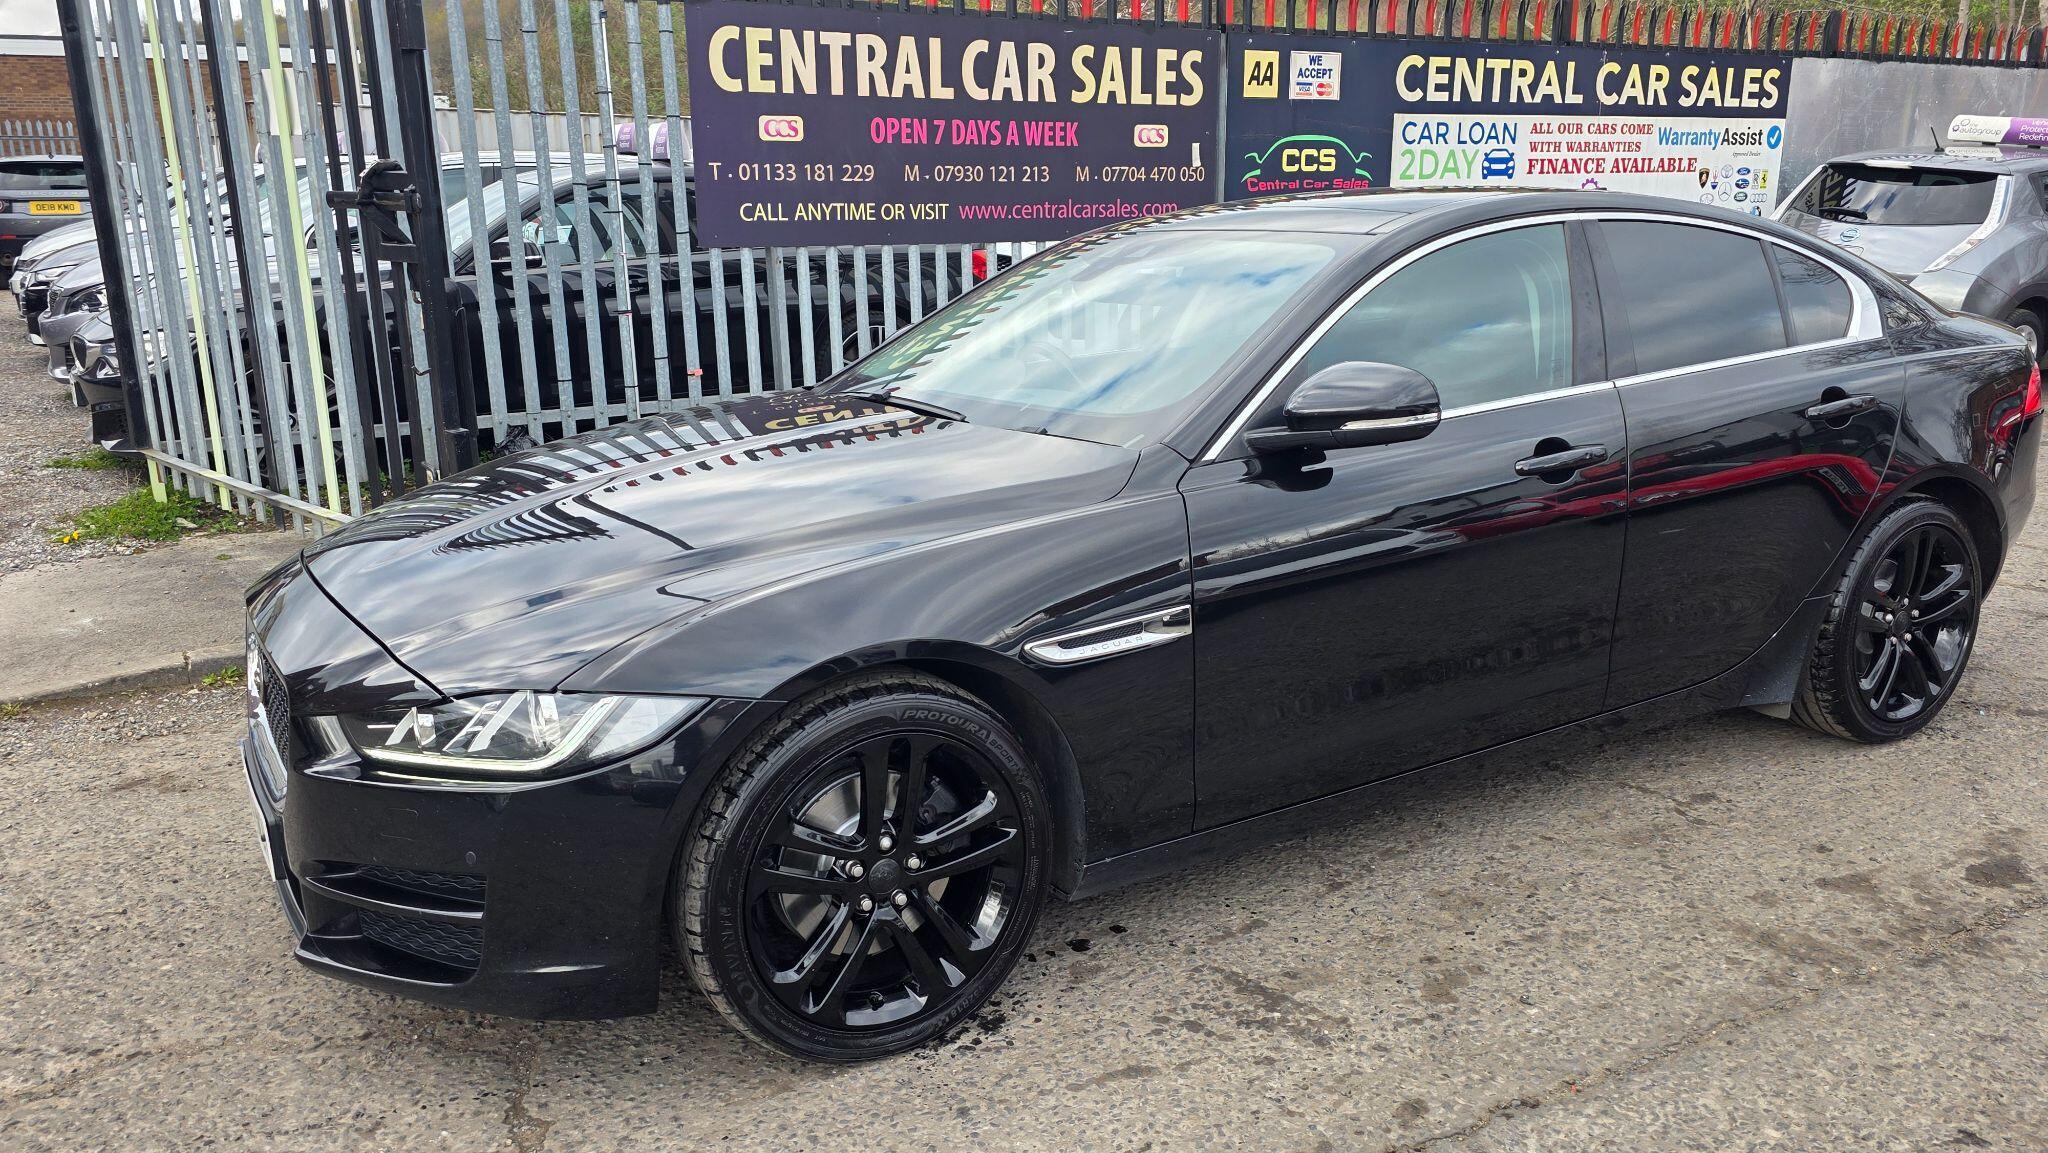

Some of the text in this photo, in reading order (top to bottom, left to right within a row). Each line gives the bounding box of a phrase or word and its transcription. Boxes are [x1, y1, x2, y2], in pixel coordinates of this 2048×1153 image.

[708, 25, 1204, 107] CENTRAL CAR SALES
[1309, 55, 1322, 66] WE
[1247, 61, 1274, 86] AA
[1297, 68, 1333, 79] ACCEPT
[1396, 55, 1781, 109] CENTRAL CAR SALES
[764, 119, 799, 138] CCS
[870, 116, 1079, 147] OPEN 7 DAYS A WEEK
[1402, 121, 1518, 145] CAR LOAN
[1530, 122, 1654, 135] ALL OUR CARS COME
[1658, 126, 1764, 150] WarrantyAssist
[1529, 141, 1642, 153] WITH WARRANTIES
[1281, 149, 1336, 172] CCS
[1400, 149, 1480, 180] 2DAY
[1527, 157, 1698, 175] FINANCE AVAILABLE
[738, 163, 796, 182] 01133
[804, 164, 834, 182] 181
[841, 164, 875, 182] 229
[934, 166, 984, 183] 07930
[990, 166, 1016, 183] 121
[1022, 166, 1050, 183] 213
[1102, 166, 1146, 182] 07704
[1150, 166, 1176, 182] 470
[1180, 166, 1205, 182] 050
[1246, 177, 1369, 192] Central Car Sales
[740, 198, 1178, 222] CALL ANYTIME OR VISIT www.centralcarsales.com
[1080, 636, 1143, 654] JAGUAR
[903, 709, 1019, 770] PROTOURA SPORT
